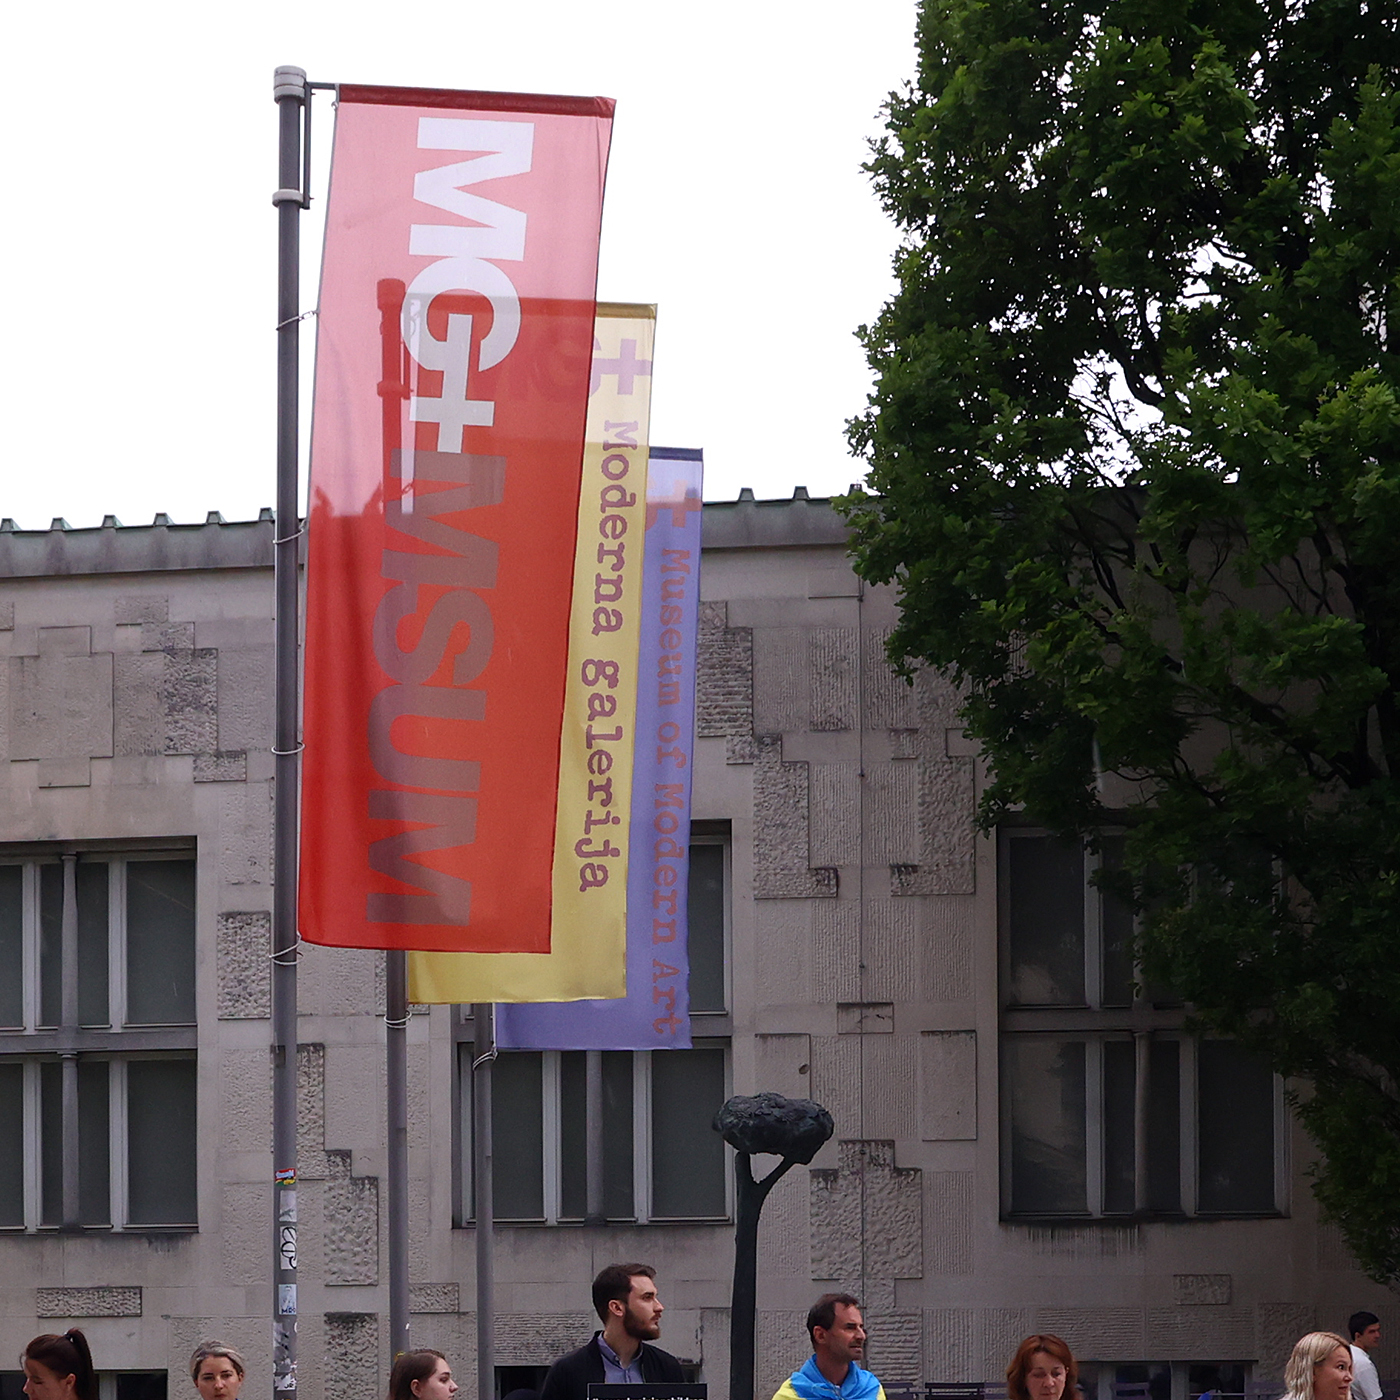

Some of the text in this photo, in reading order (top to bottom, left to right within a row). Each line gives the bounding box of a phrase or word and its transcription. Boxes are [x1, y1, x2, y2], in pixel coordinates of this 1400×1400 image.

[591, 420, 639, 637] Moderna
[656, 548, 691, 707] Museum
[574, 659, 623, 893] galerija
[656, 722, 687, 769] of
[651, 783, 685, 946] Modern
[651, 959, 683, 1037] Art
